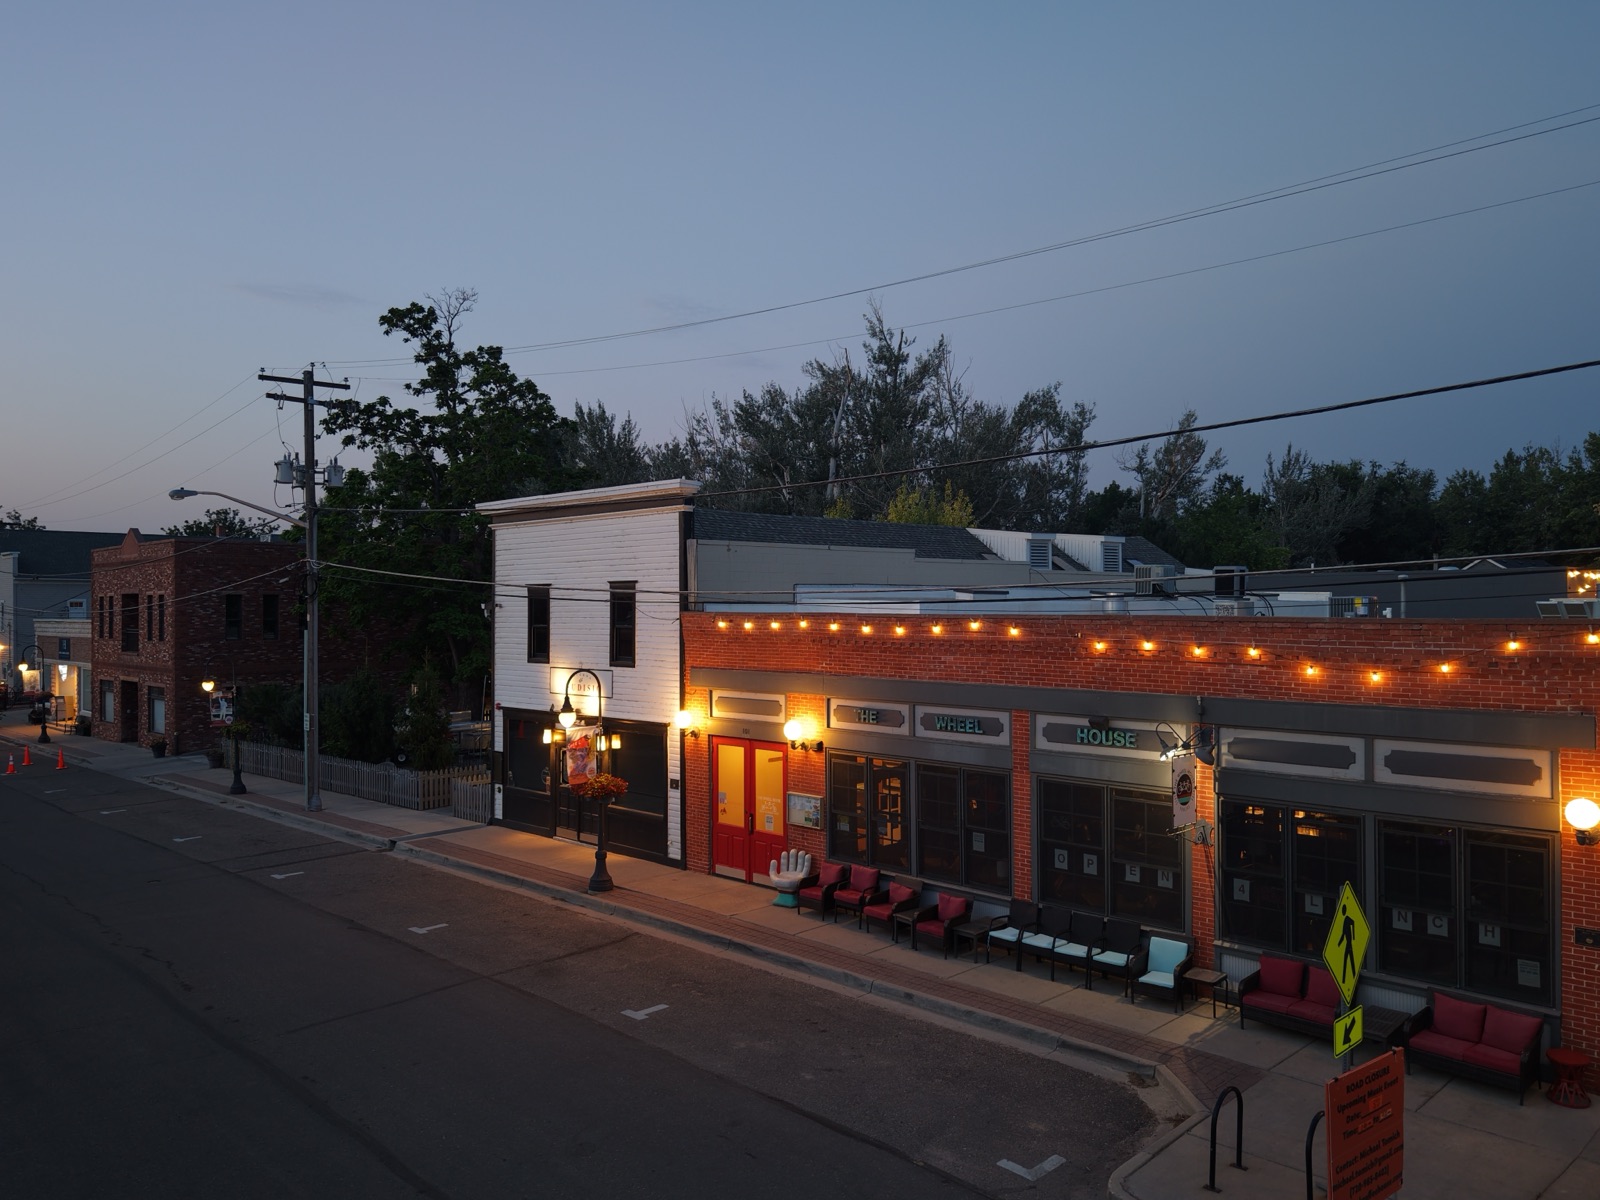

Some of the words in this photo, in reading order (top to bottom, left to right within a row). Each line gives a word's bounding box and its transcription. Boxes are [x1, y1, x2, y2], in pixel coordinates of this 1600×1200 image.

[853, 709, 878, 724] THE
[935, 716, 984, 734] WHEEL
[1076, 727, 1137, 748] HOUSE
[1238, 884, 1246, 895] 4
[1346, 1079, 1364, 1094] ROAD
[1365, 1065, 1390, 1085] CLOSURE
[1337, 1094, 1366, 1114] Upcoming
[1367, 1085, 1383, 1098] Music
[1384, 1076, 1399, 1090] Event
[1336, 1155, 1359, 1174] Contact:
[1360, 1139, 1380, 1160] Michael
